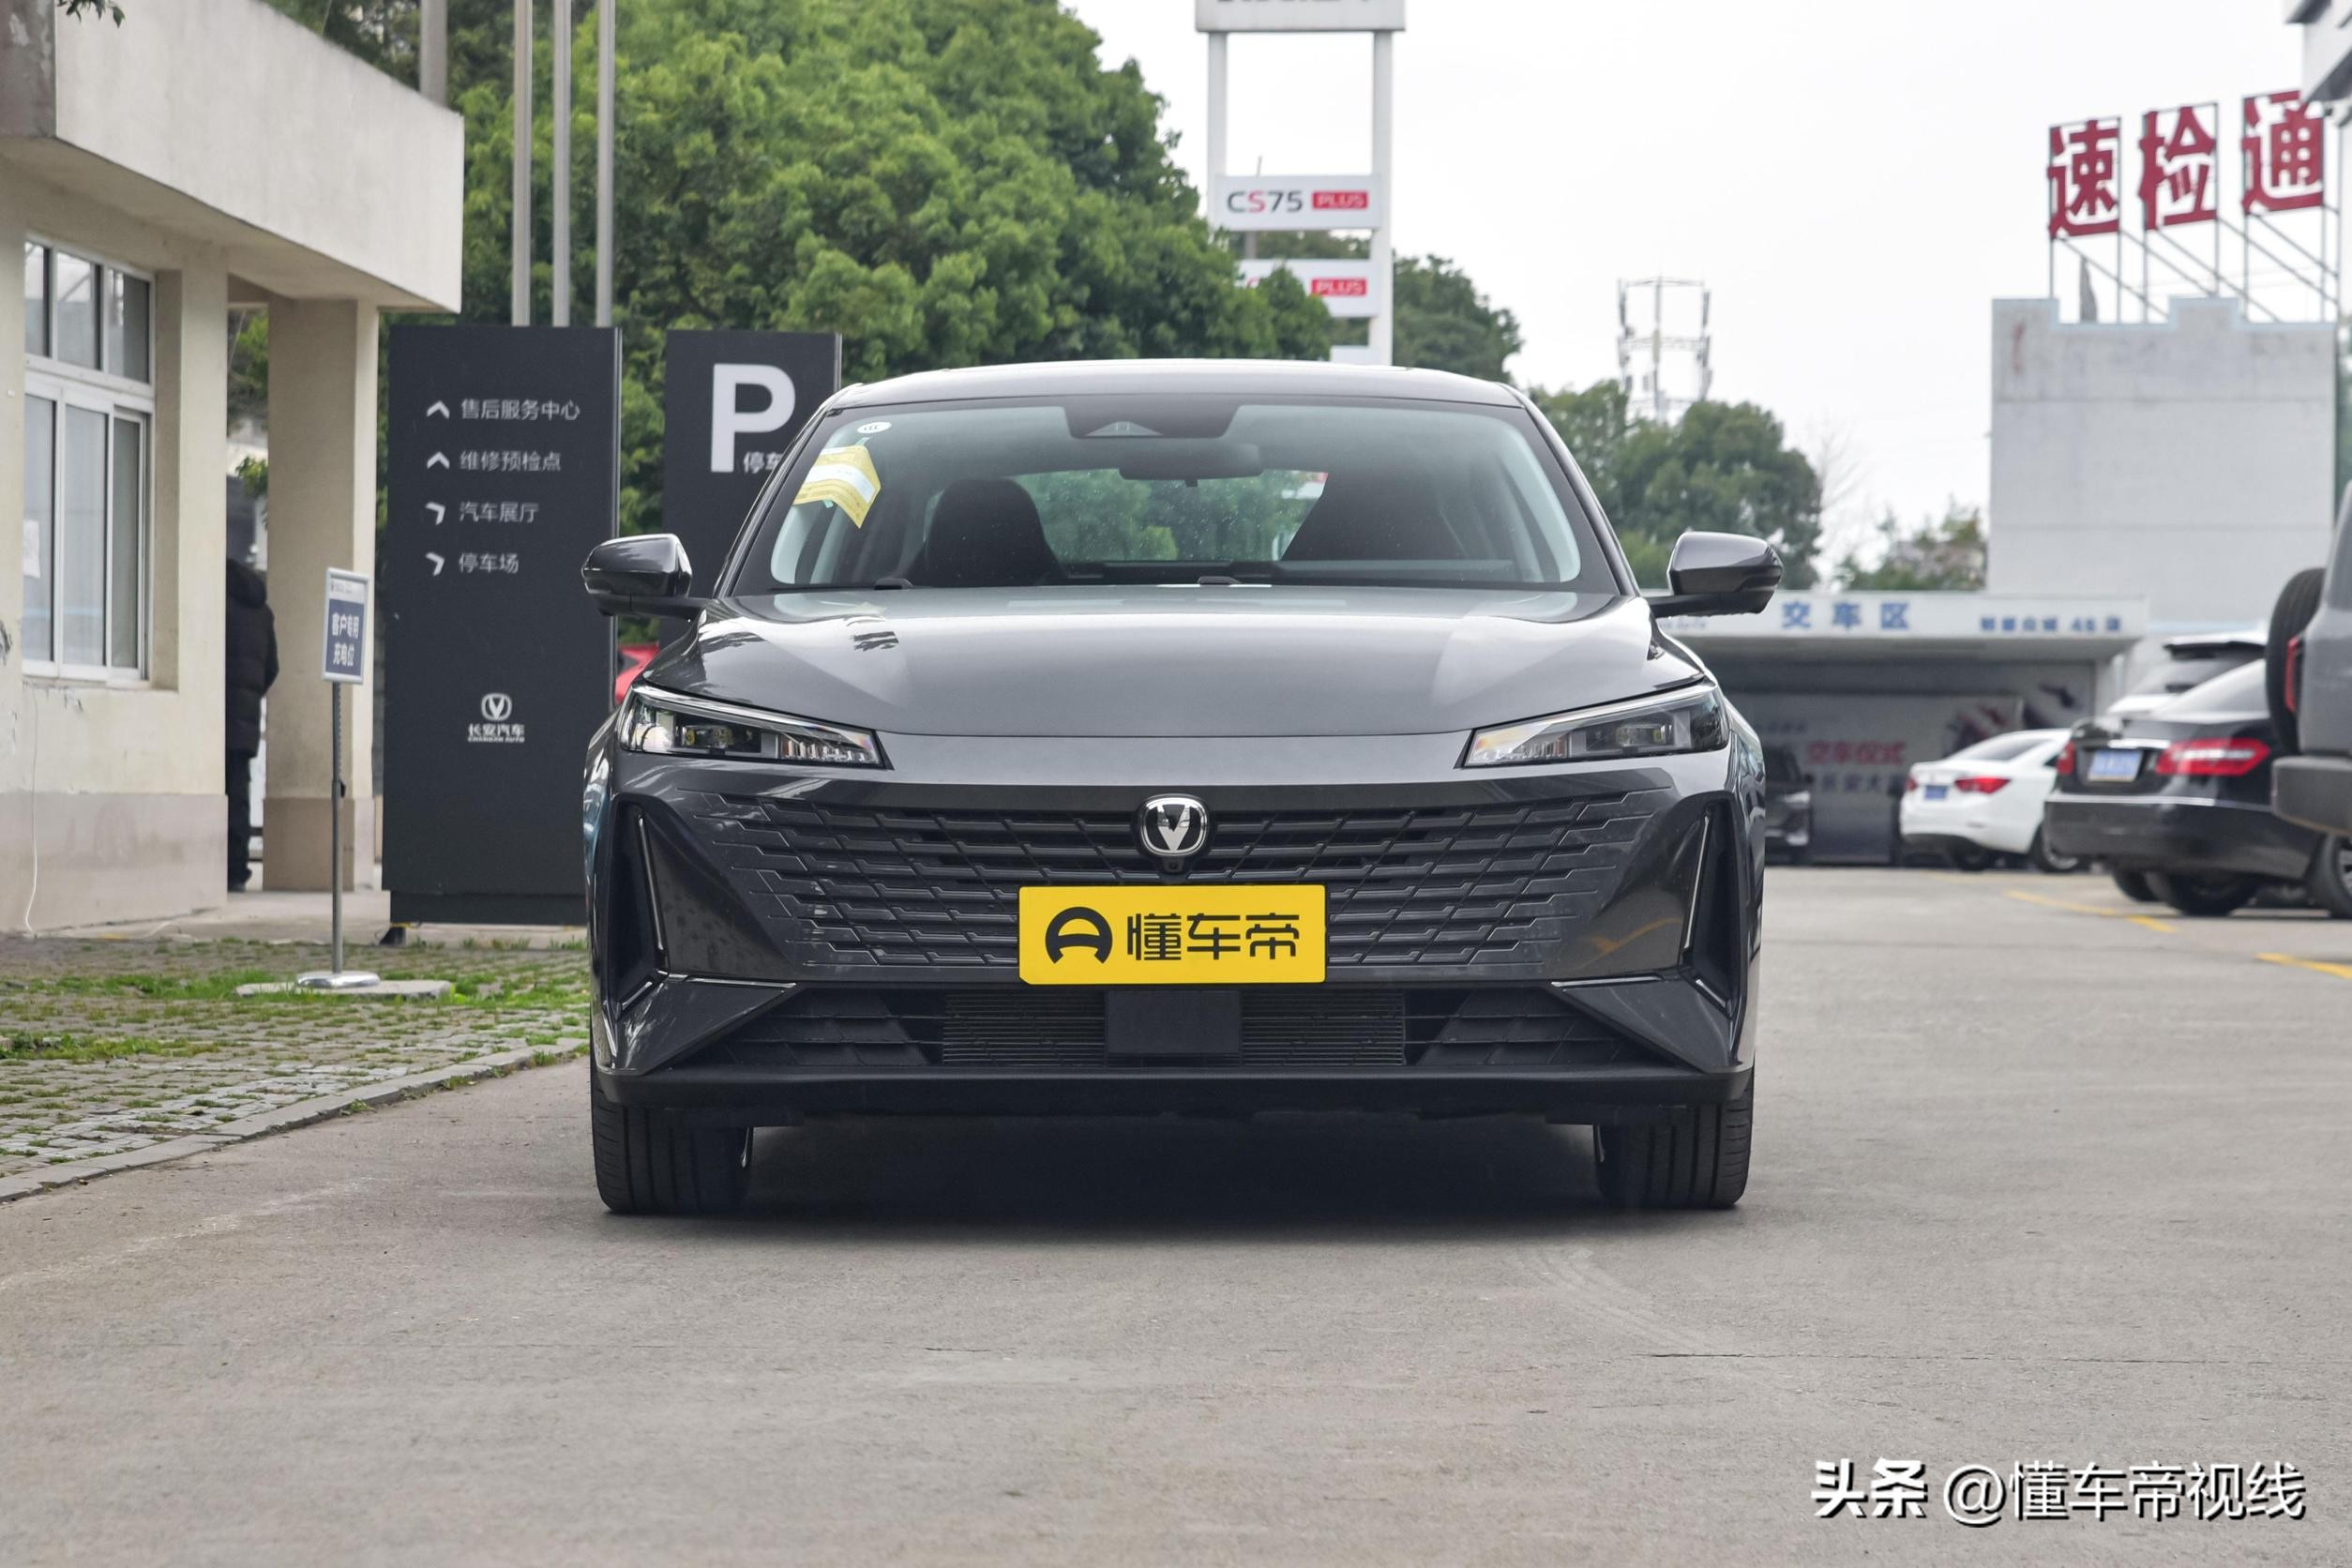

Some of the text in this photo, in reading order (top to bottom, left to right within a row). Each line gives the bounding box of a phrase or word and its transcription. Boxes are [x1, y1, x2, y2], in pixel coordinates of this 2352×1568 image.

[2047, 90, 2324, 239] 速检通
[1227, 190, 1365, 213] CS75 PLUS
[1315, 280, 1364, 295] PLUS
[460, 399, 580, 421] 售后服务中心
[711, 363, 795, 473] P
[460, 451, 562, 472] 维修预检点
[460, 502, 539, 524] 汽车展厅
[459, 552, 520, 575] 停车场
[1783, 601, 1910, 632] 交车区
[468, 723, 525, 737] 长安汽车
[1127, 912, 1300, 961] 懂车帝
